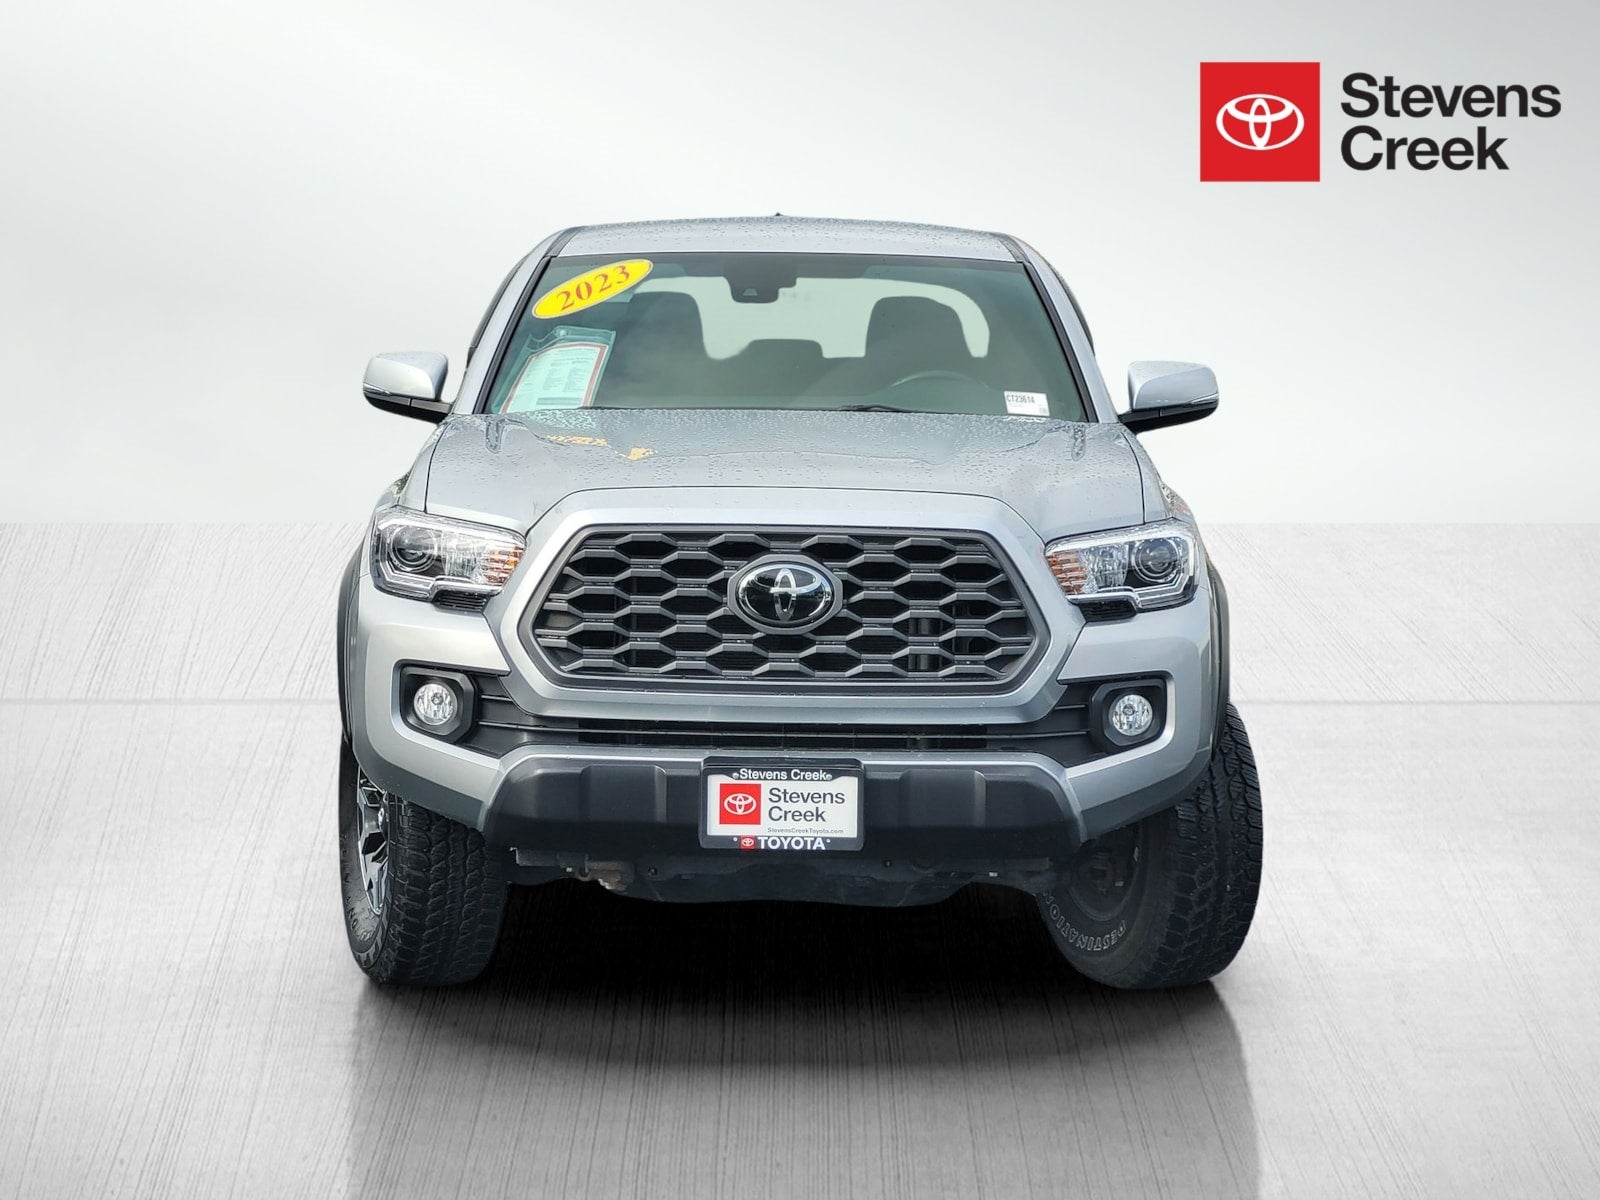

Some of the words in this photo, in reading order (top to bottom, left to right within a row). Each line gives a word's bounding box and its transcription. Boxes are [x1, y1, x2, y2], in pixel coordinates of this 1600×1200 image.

[556, 264, 630, 311] 2023
[739, 768, 788, 780] Stevens
[790, 769, 828, 781] Creek
[768, 787, 845, 804] Stevens
[768, 806, 826, 822] Creek
[767, 827, 844, 835] StevensCreekToyota.com
[757, 836, 826, 850] TOYOTA
